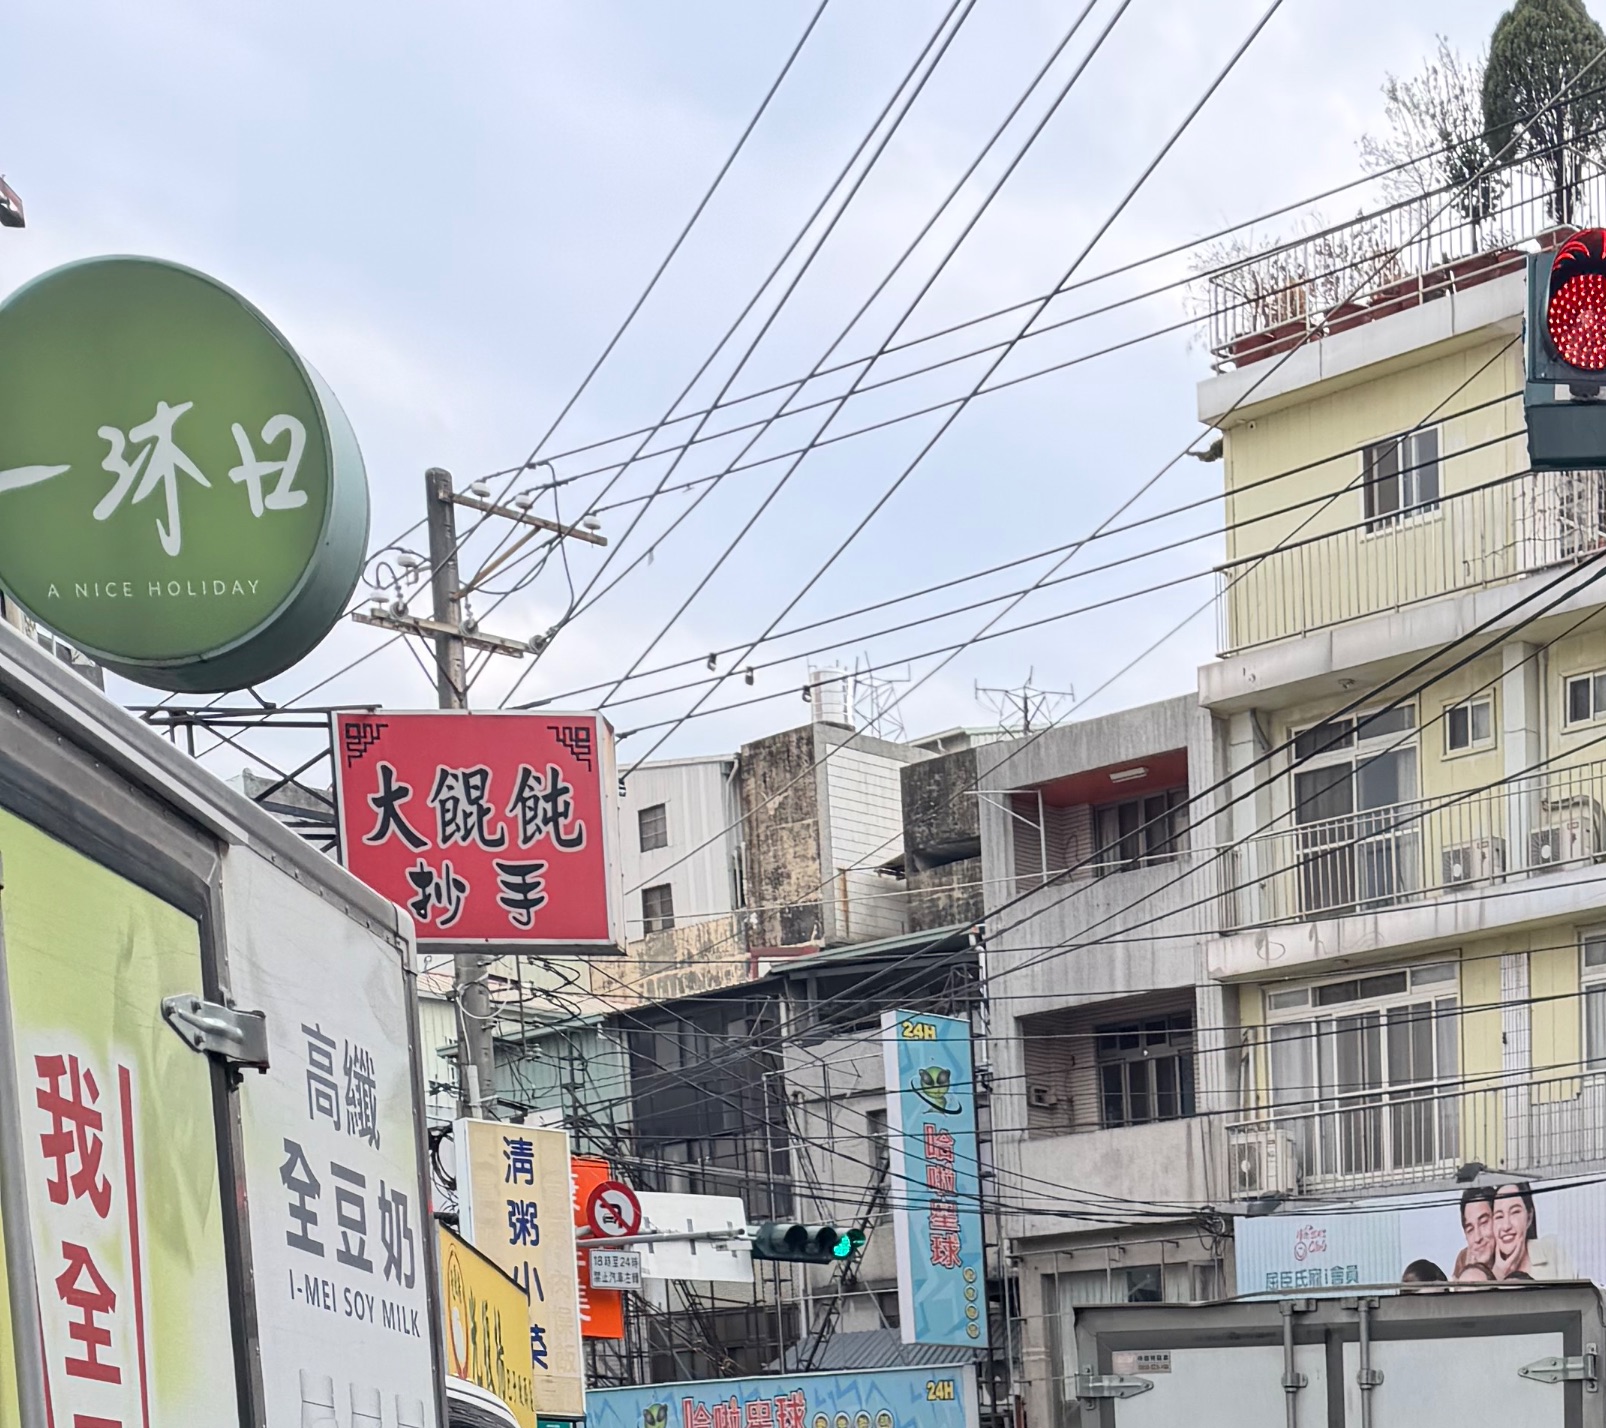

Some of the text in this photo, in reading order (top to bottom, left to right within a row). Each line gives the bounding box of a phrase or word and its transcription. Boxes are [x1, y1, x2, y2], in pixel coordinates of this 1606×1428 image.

[47, 579, 260, 599] A NICE HOLIDAY
[362, 762, 588, 854] 大餛飩
[406, 860, 550, 931] 抄手
[902, 1021, 938, 1042] 24H
[301, 1023, 380, 1151] 高纖
[279, 1136, 416, 1290] 全豆奶
[288, 1268, 421, 1339] I-MEI SOY MILK
[926, 1380, 954, 1401] 24H
